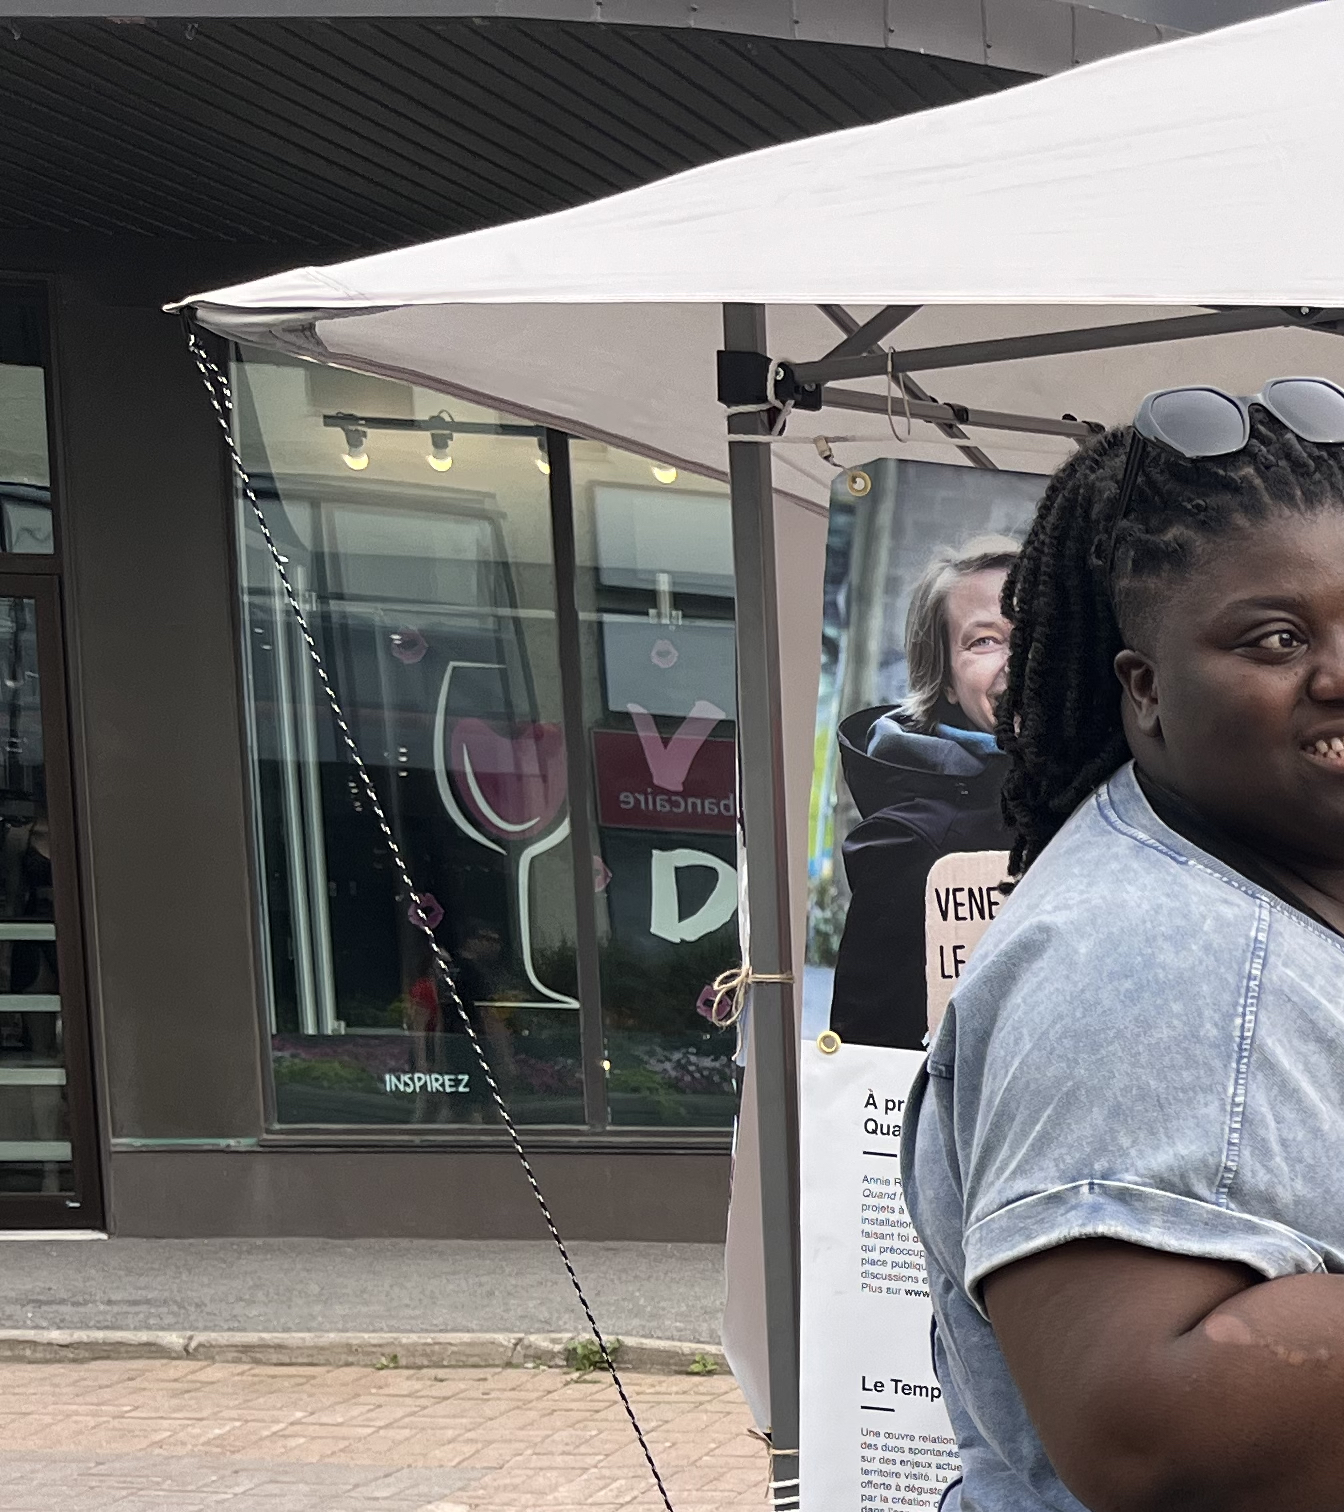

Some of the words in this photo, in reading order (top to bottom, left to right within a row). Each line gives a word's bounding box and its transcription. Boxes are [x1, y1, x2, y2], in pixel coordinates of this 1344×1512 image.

[627, 701, 727, 791] V
[650, 849, 738, 943] D
[935, 886, 999, 921] VENE
[385, 1073, 470, 1094] INSPIREZ
[863, 1088, 878, 1109] À
[884, 1098, 905, 1115] pr
[864, 1118, 901, 1139] Qua
[862, 1174, 891, 1186] Annie
[862, 1188, 897, 1200] Quand
[861, 1202, 895, 1214] projets
[898, 1205, 905, 1215] à
[861, 1216, 912, 1229] installation
[861, 1229, 894, 1242] faisant
[897, 1234, 909, 1243] foi
[861, 1243, 876, 1254] qui
[879, 1246, 925, 1258] préoccup
[861, 1257, 888, 1267] place
[891, 1259, 926, 1272] publiqu
[861, 1270, 919, 1283] discussions
[861, 1283, 883, 1294] Plus
[885, 1285, 901, 1295] sur
[904, 1288, 930, 1298] www
[861, 1375, 885, 1393] Le
[890, 1378, 942, 1402] Temp
[861, 1427, 881, 1438] Une
[884, 1431, 916, 1442] œuvre
[918, 1434, 957, 1446] relation
[861, 1441, 879, 1451] des
[881, 1443, 905, 1454] duos
[908, 1446, 960, 1459] spontanés
[861, 1454, 876, 1463] sur
[879, 1456, 897, 1466] des
[900, 1459, 933, 1470] enjeux
[936, 1461, 962, 1472] actue
[861, 1467, 901, 1479] territoire
[904, 1472, 932, 1482] visité.
[936, 1474, 948, 1484] La
[861, 1480, 892, 1491] offerte
[895, 1482, 902, 1493] à
[904, 1484, 943, 1496] déguste
[861, 1493, 877, 1504] par
[880, 1493, 889, 1503] la
[891, 1495, 931, 1507] création
